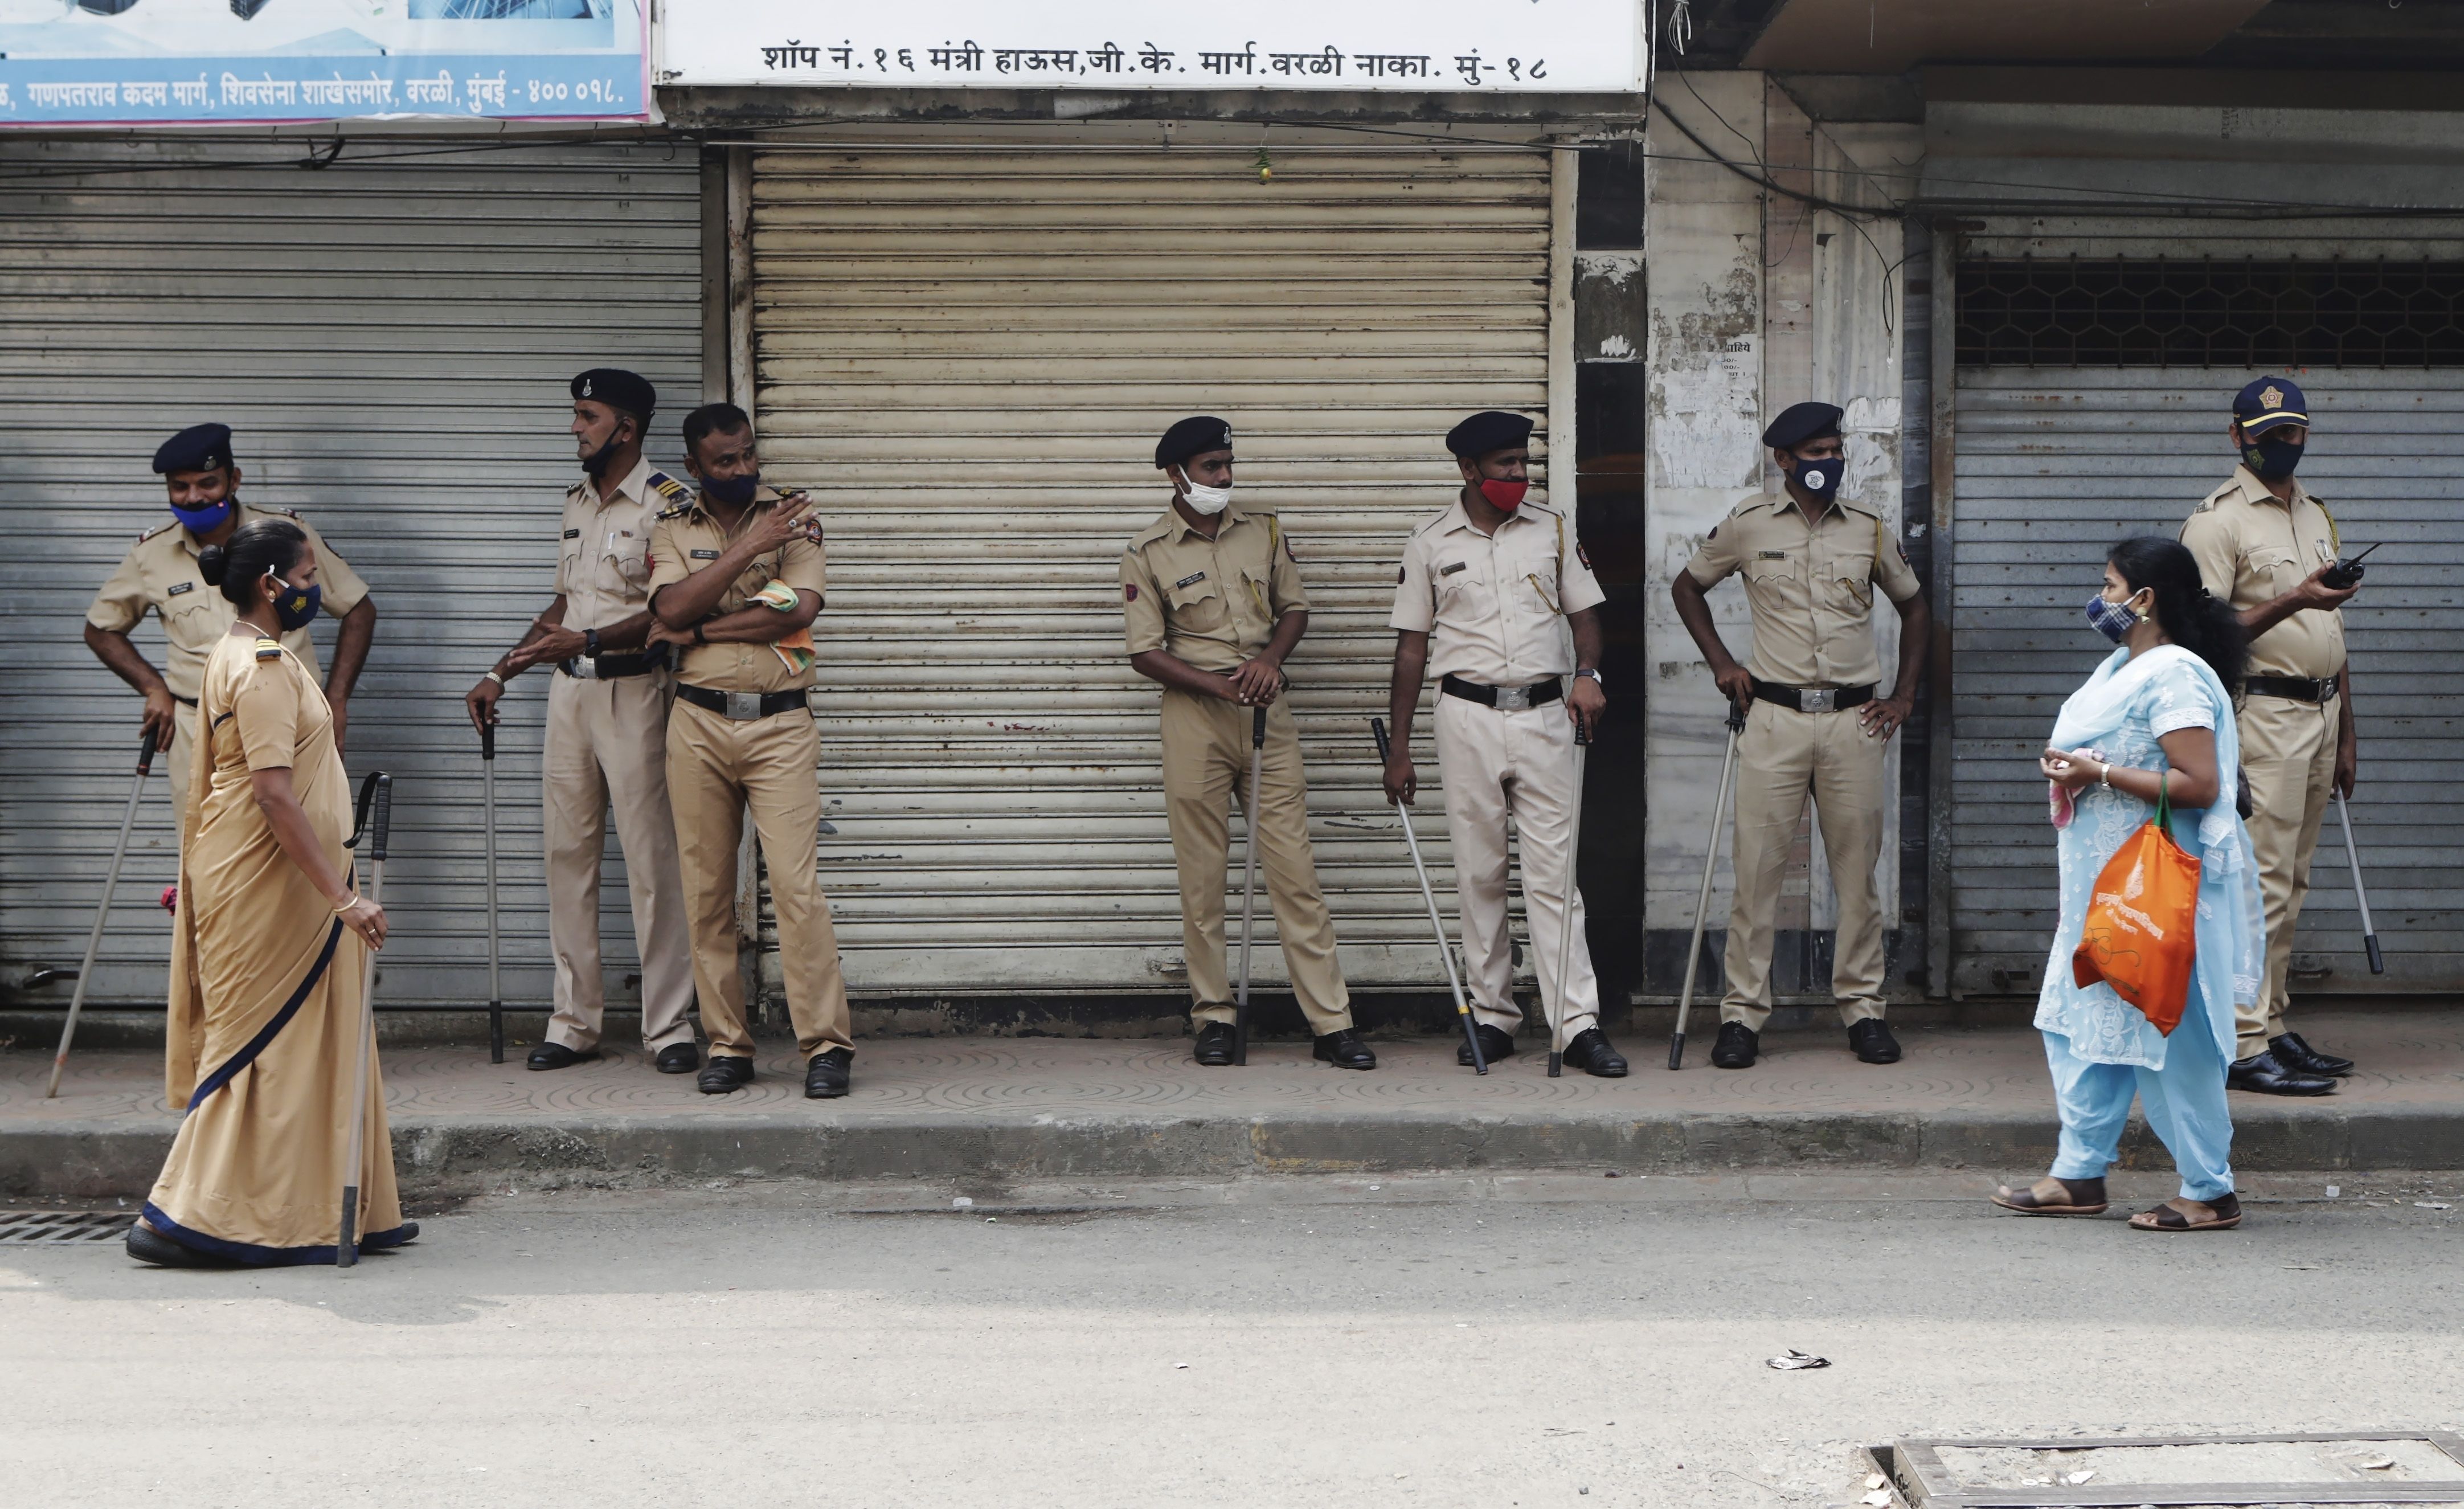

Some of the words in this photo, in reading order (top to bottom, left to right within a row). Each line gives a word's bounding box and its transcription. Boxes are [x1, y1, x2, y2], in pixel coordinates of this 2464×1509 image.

[760, 39, 820, 68] शॉप
[927, 40, 985, 72] मंत्री
[1353, 55, 1441, 77] नाका.
[27, 82, 118, 107] गणपतराव
[121, 81, 168, 107] कदम
[172, 72, 215, 109] मार्ग,
[220, 71, 297, 105] शिवसेना
[301, 71, 400, 107] शाखेसमोर,
[405, 69, 461, 107] वरळी,
[466, 69, 507, 113] मुंबई
[528, 79, 568, 103] ४००
[575, 79, 623, 103] ०१८.
